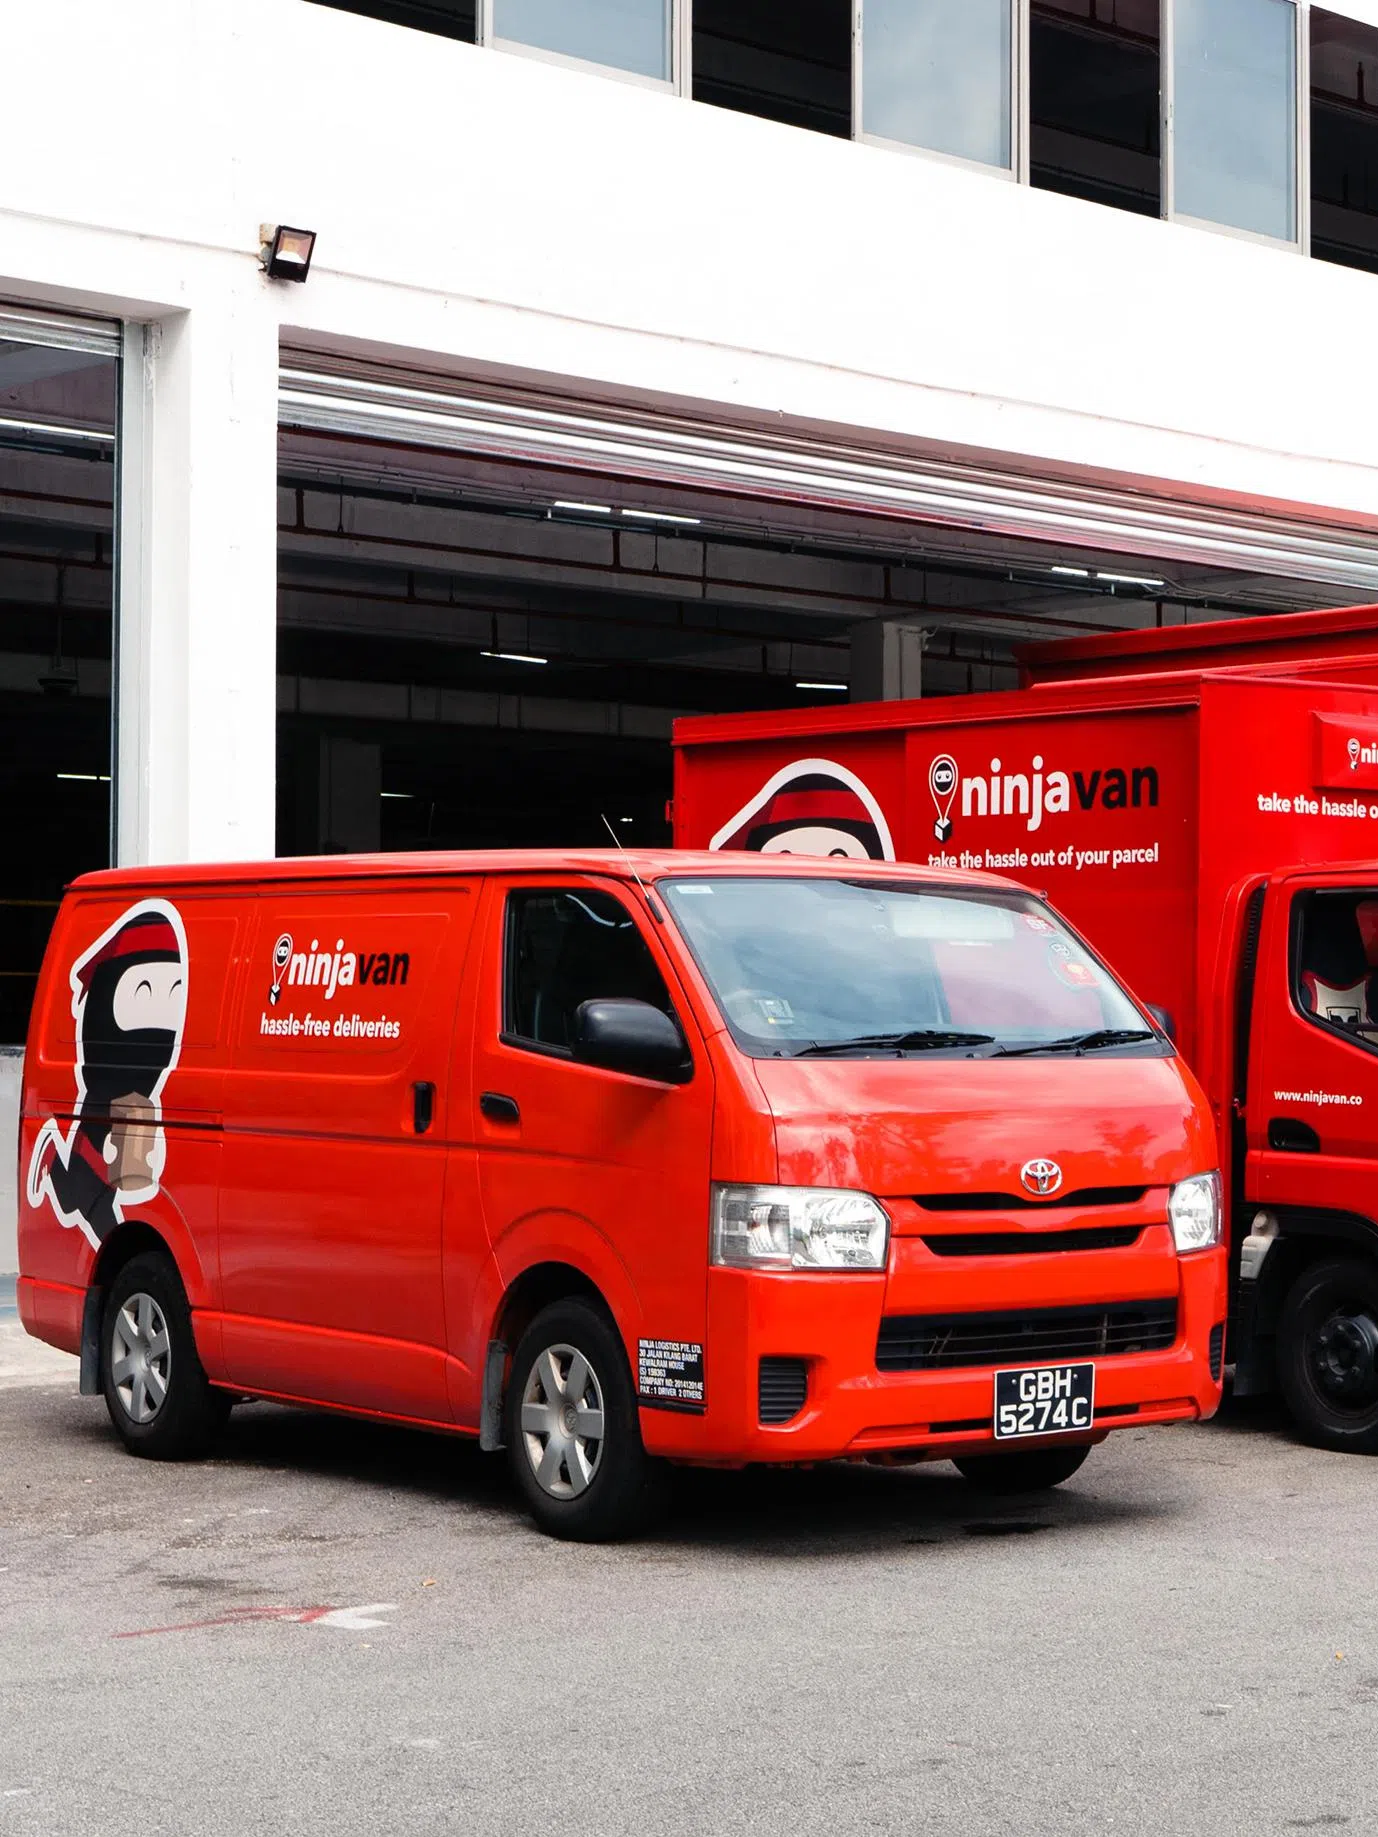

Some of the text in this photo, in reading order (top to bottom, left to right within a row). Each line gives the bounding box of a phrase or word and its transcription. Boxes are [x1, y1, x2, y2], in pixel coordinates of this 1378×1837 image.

[961, 755, 1159, 832] ninjavan
[1257, 792, 1291, 813] take
[1294, 794, 1318, 814] the
[1321, 796, 1366, 818] hassle
[928, 842, 1159, 870] take the hassle out of your parcel
[287, 939, 410, 1000] ninjavan
[260, 1012, 400, 1039] hassle-free deliveries
[1274, 1090, 1363, 1106] www.ninjavan.co
[639, 1339, 654, 1349] NINJA
[655, 1340, 680, 1352] LOGISTICS
[646, 1349, 663, 1358] JALAN
[668, 1361, 685, 1370] HOUSE
[640, 1376, 665, 1386] COMPANY
[640, 1385, 650, 1394] PAX
[657, 1387, 676, 1397] DRIVER
[678, 1389, 682, 1397] 2
[683, 1389, 702, 1400] OTHERS
[1019, 1368, 1072, 1401] GBH
[1000, 1397, 1088, 1434] 5274C
